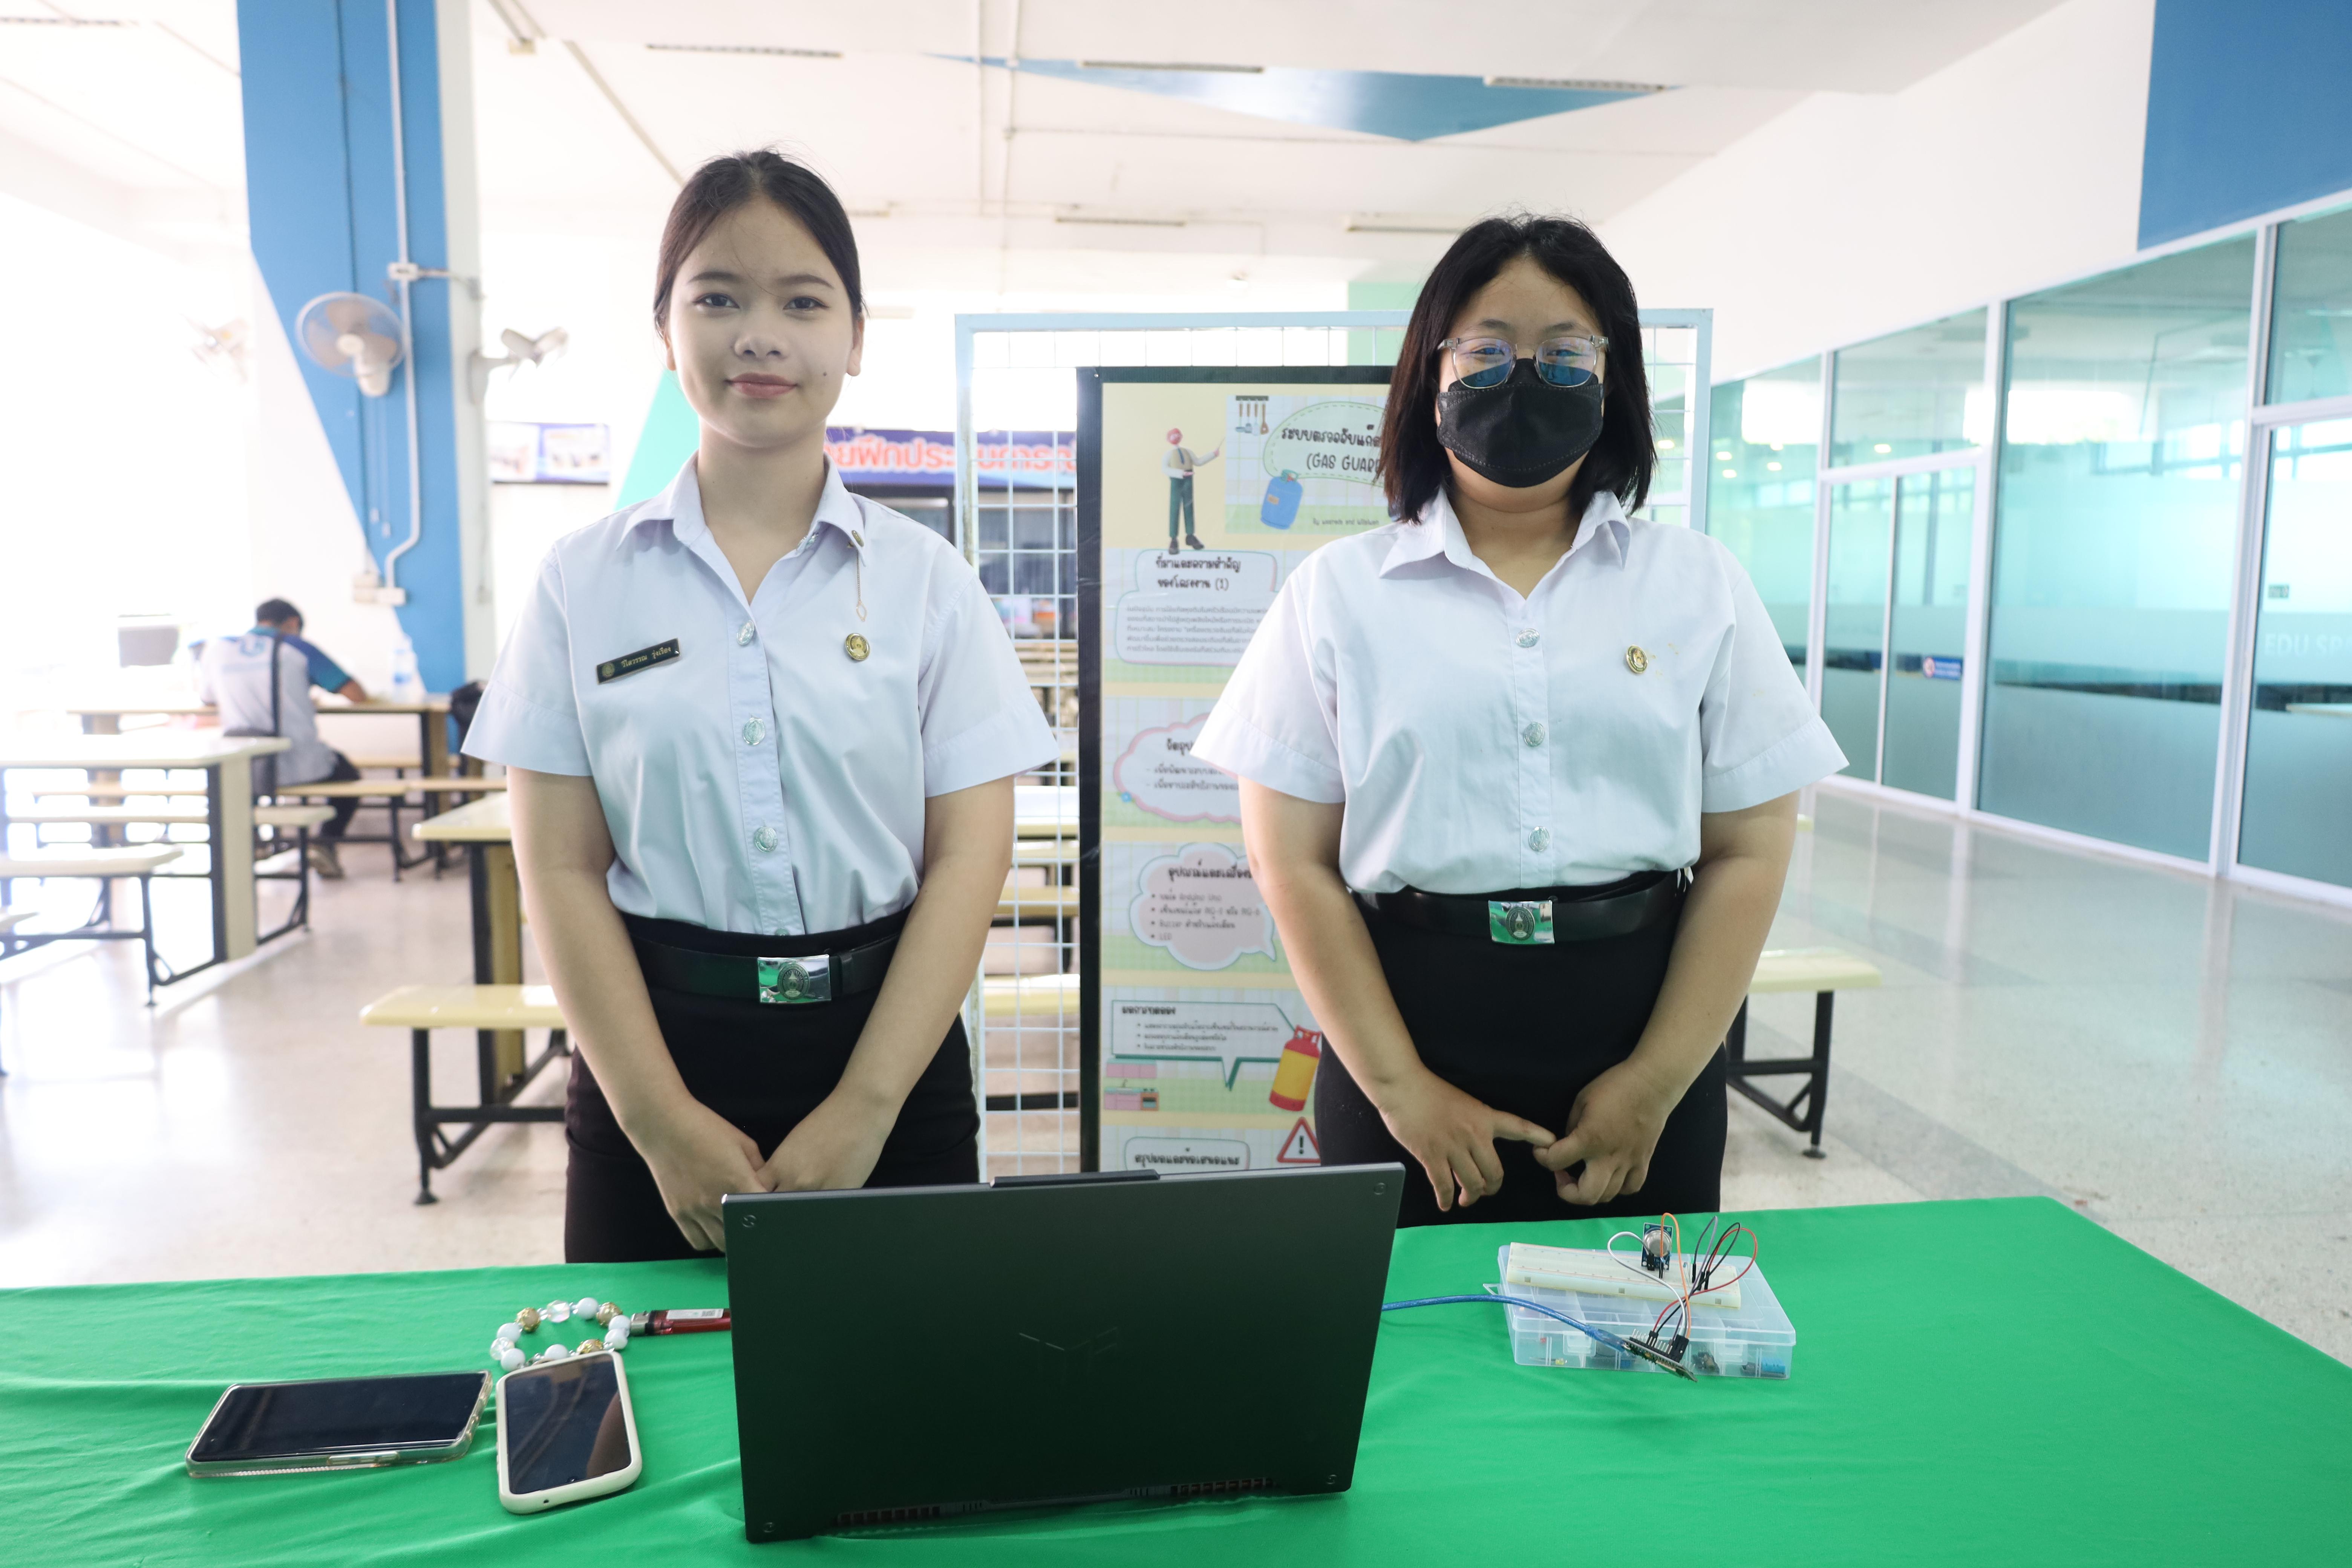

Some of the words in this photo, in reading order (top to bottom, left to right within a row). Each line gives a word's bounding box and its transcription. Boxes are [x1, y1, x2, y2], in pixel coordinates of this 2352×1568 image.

[1307, 452, 1336, 470] (GAS
[1156, 552, 1241, 573] ที่มาและความสำคัญ
[1215, 577, 1229, 591] (1)
[621, 655, 648, 668] วิไลวรรณ
[651, 646, 671, 659] รุ่งเรือง
